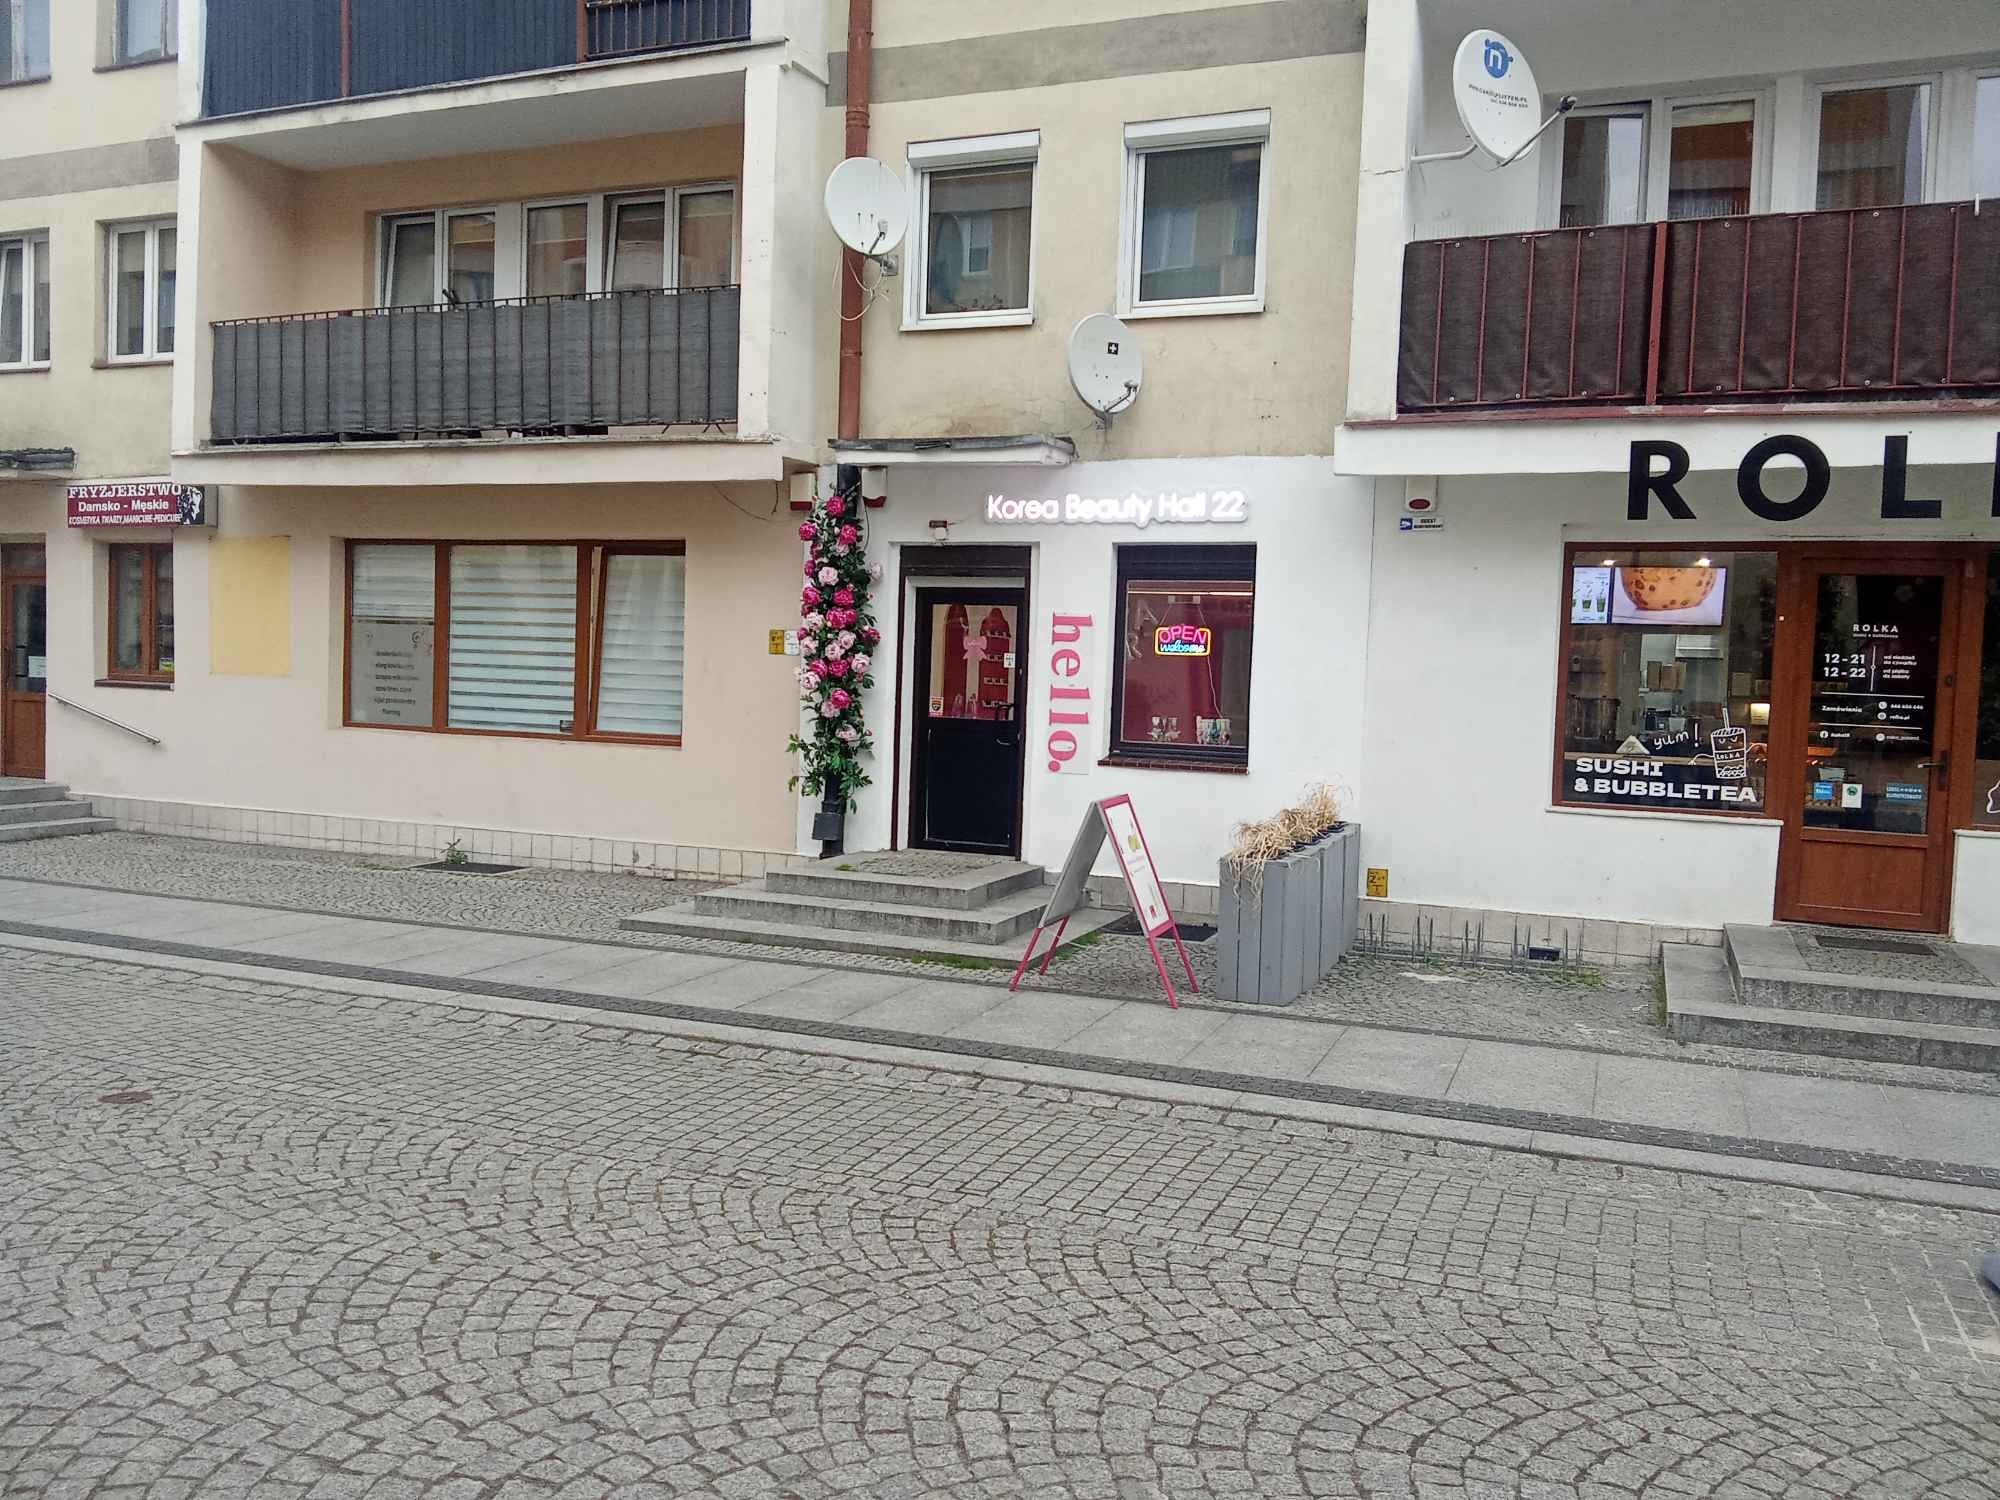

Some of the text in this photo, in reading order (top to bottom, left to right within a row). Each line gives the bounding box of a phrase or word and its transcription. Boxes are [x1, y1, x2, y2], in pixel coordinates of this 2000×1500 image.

[1627, 432, 2000, 521] ROL
[68, 483, 181, 498] FRYZJERSTWO
[78, 501, 120, 512] Damsko
[131, 499, 169, 513] Męskie
[987, 490, 1245, 526] Korea Beauty Hall 22
[1159, 625, 1206, 644] OPEN
[1853, 624, 1899, 633] ROLKA
[1048, 612, 1093, 773] hello.
[1575, 757, 1664, 777] SUSHI
[1574, 777, 1757, 803] & BUBBLETEA
